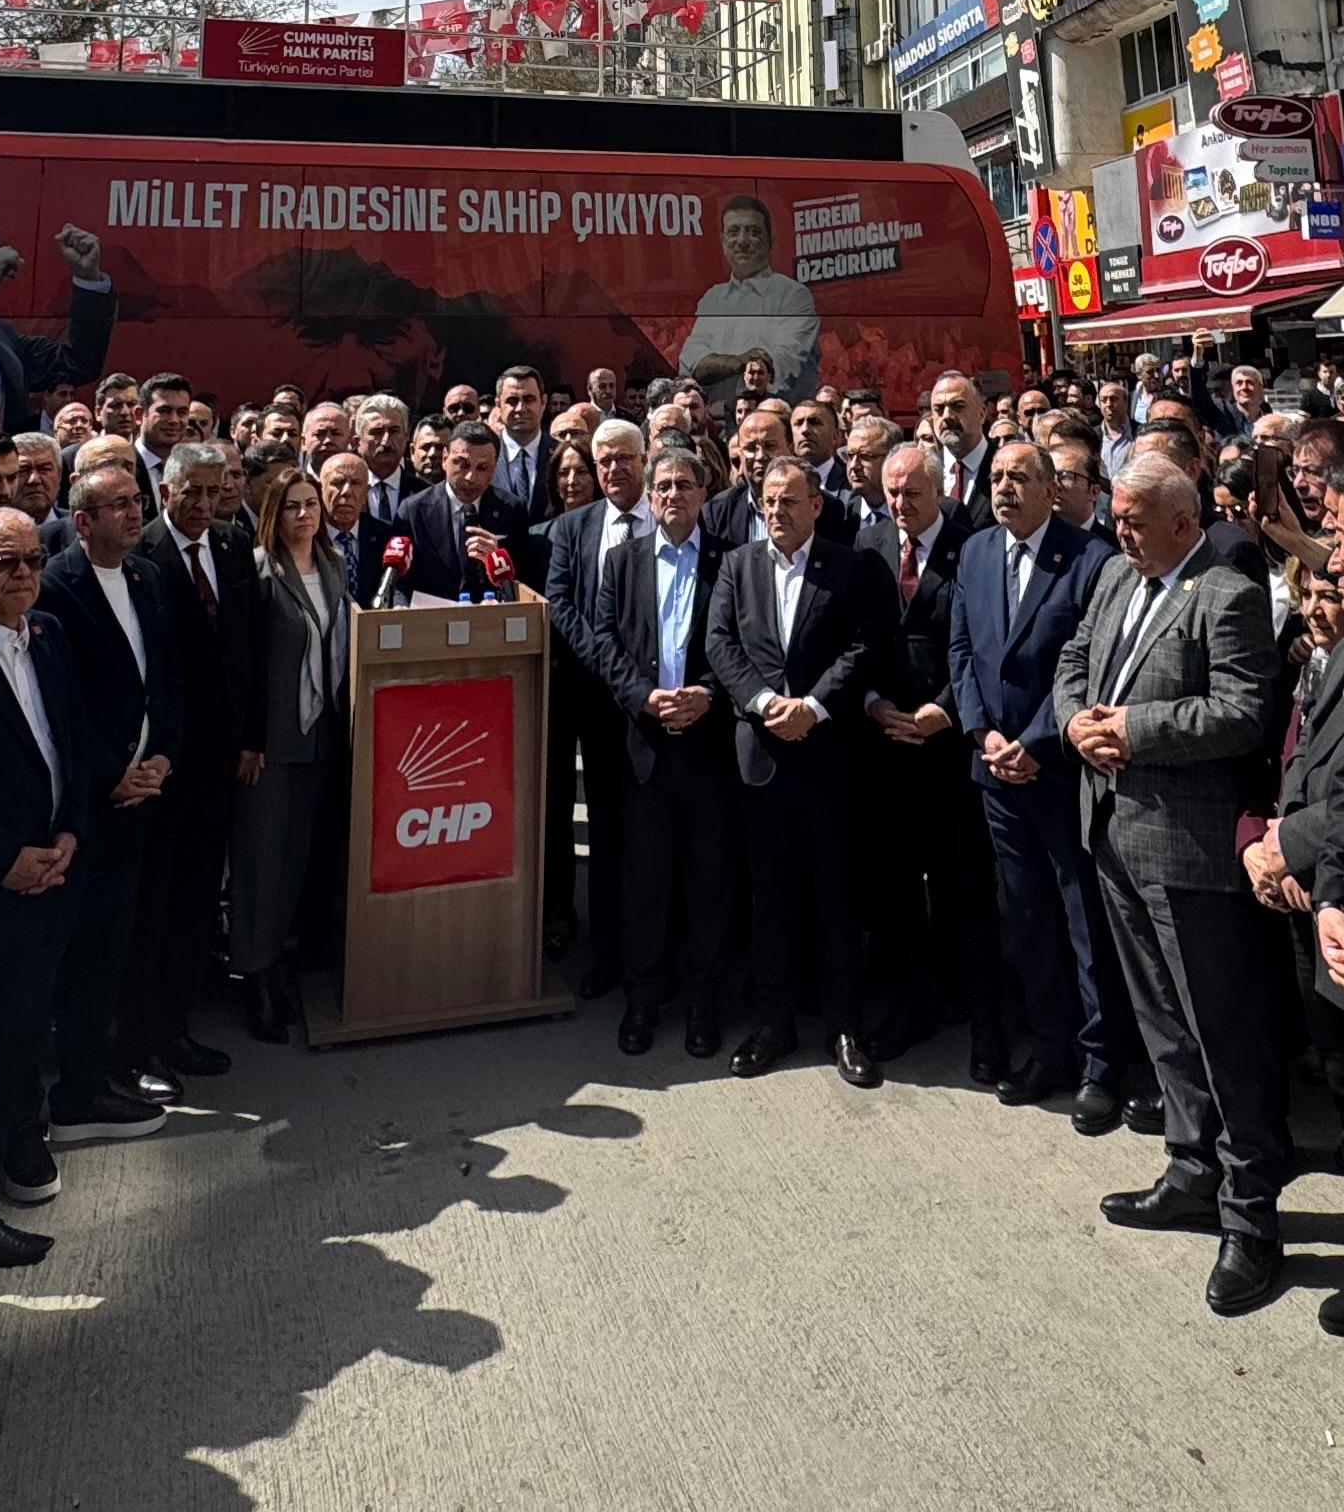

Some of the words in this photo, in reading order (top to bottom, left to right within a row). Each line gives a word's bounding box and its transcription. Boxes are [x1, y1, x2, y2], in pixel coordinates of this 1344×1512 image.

[438, 24, 463, 32] CHP
[283, 31, 375, 48] CUMHURİYET
[894, 37, 936, 74] ANADOLU
[937, 5, 985, 45] SİGORTA
[283, 46, 320, 59] HALK
[323, 46, 375, 62] PARTİSİ
[238, 59, 300, 76] Türkiye'nin
[301, 63, 337, 76] Birinci
[339, 64, 374, 78] Partisi
[1251, 144, 1269, 154] Her
[1272, 144, 1307, 154] zaman
[1268, 164, 1309, 178] Taptaze
[107, 179, 249, 228] MİLLET
[572, 191, 703, 242] ÇIKIYOR
[794, 202, 861, 232] EKREM
[796, 247, 897, 283] ÖZGÜRLÜK
[395, 801, 493, 849] CHP
